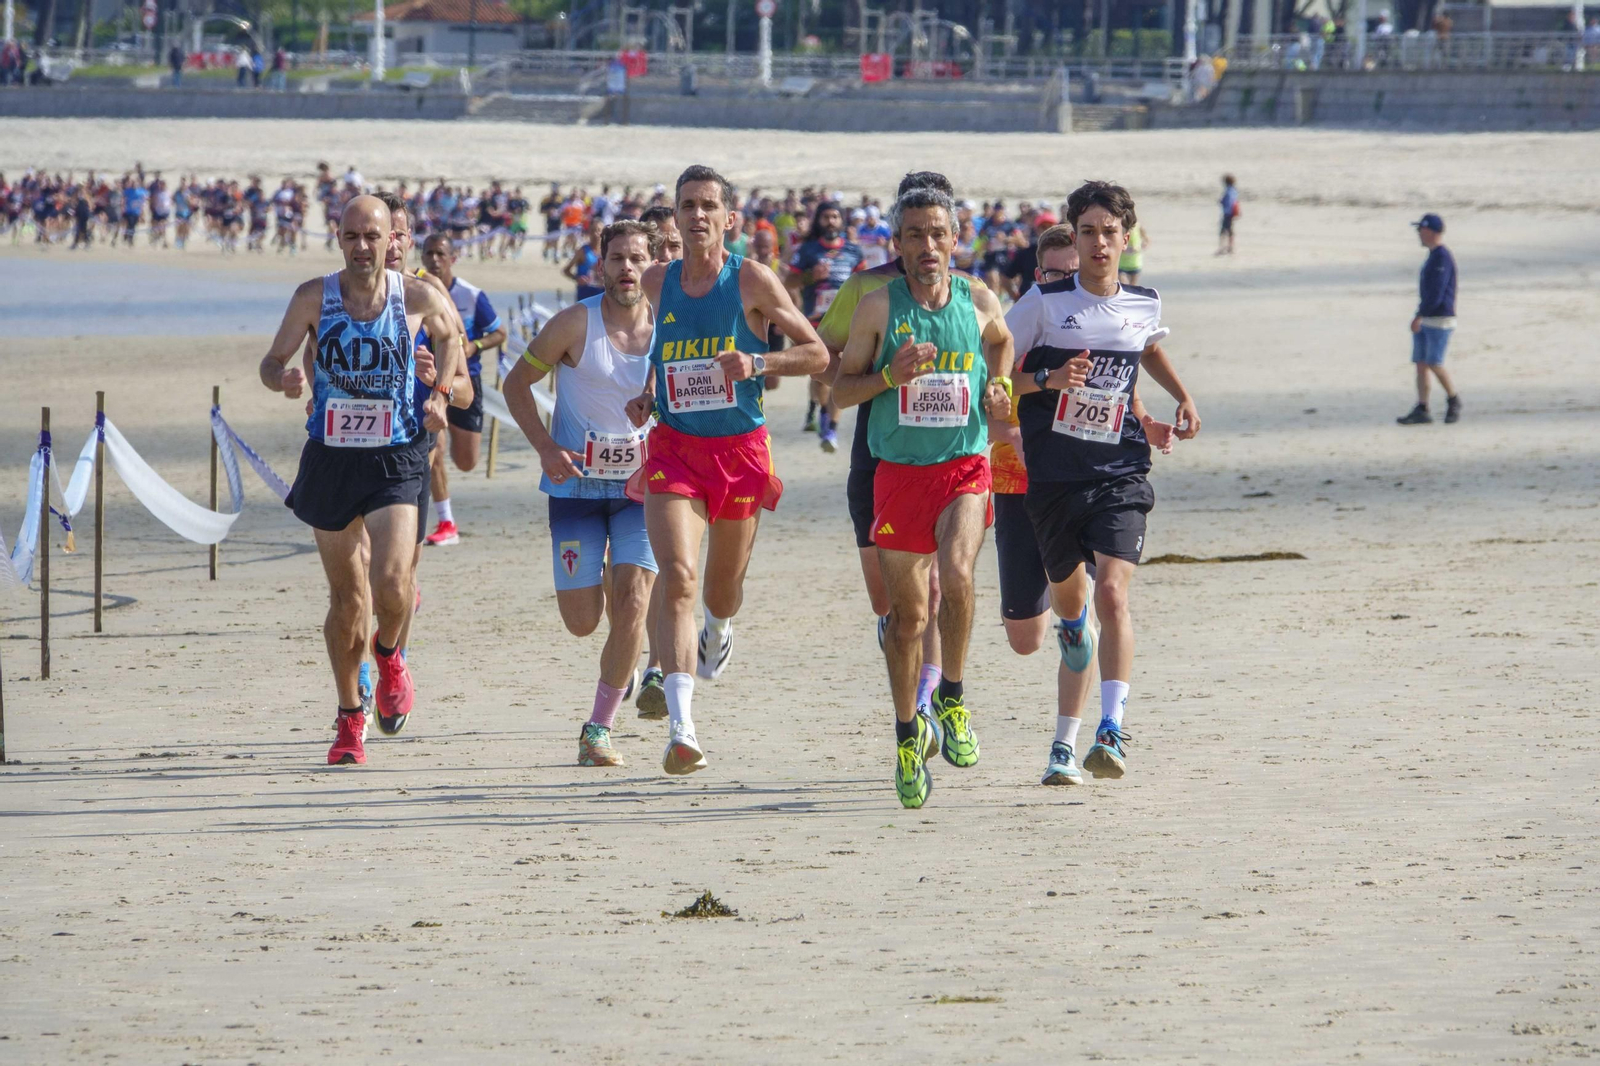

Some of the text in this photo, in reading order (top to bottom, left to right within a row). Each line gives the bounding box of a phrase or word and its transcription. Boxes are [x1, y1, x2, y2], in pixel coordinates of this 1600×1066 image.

[324, 336, 408, 372] ADN
[327, 374, 405, 390] RUNNERS
[687, 375, 712, 387] DANI
[1103, 379, 1121, 389] fresh
[676, 384, 726, 398] BARGIELA
[917, 390, 951, 402] JESÚS
[912, 400, 956, 412] ESPAÑA
[1073, 401, 1111, 424] 705
[340, 414, 377, 431] 277
[599, 447, 635, 463] 455
